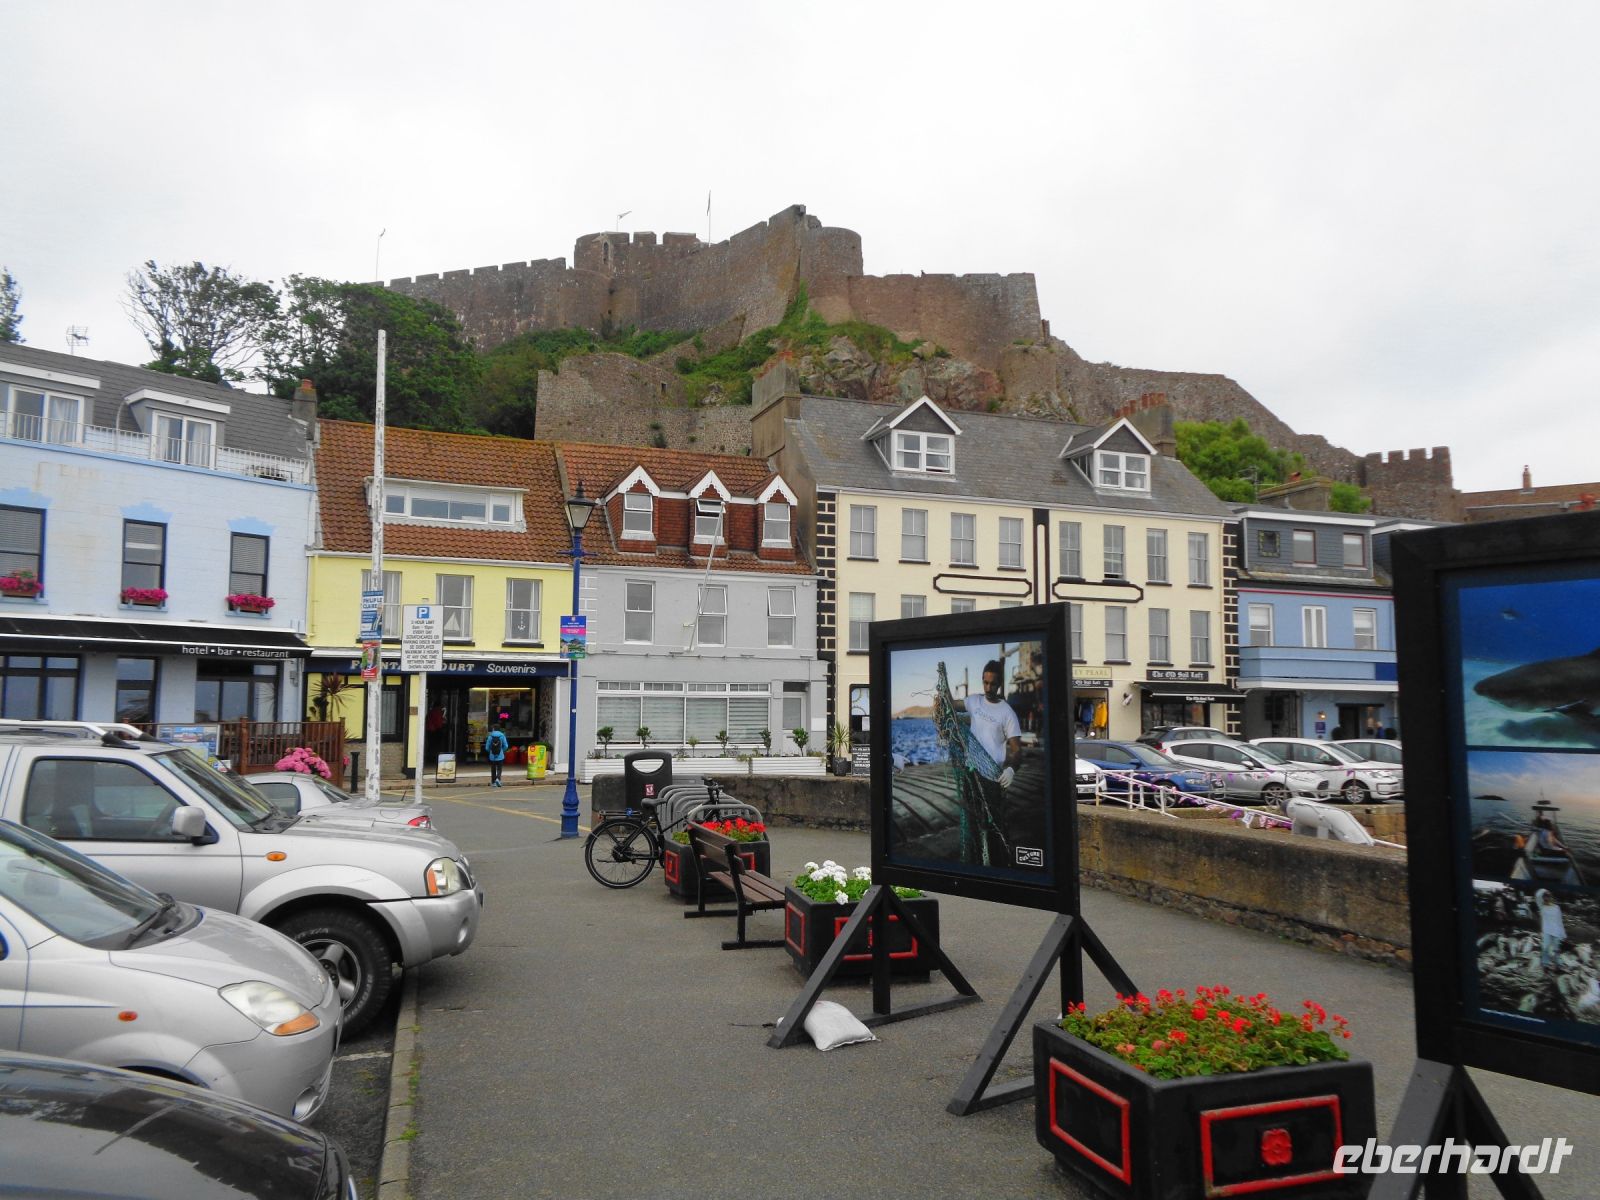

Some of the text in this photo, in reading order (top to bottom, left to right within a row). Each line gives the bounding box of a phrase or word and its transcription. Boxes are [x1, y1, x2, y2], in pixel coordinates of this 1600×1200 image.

[182, 645, 208, 654] hotel
[218, 647, 234, 655] bar
[441, 662, 474, 671] OURT
[486, 663, 536, 674] Souvenirs
